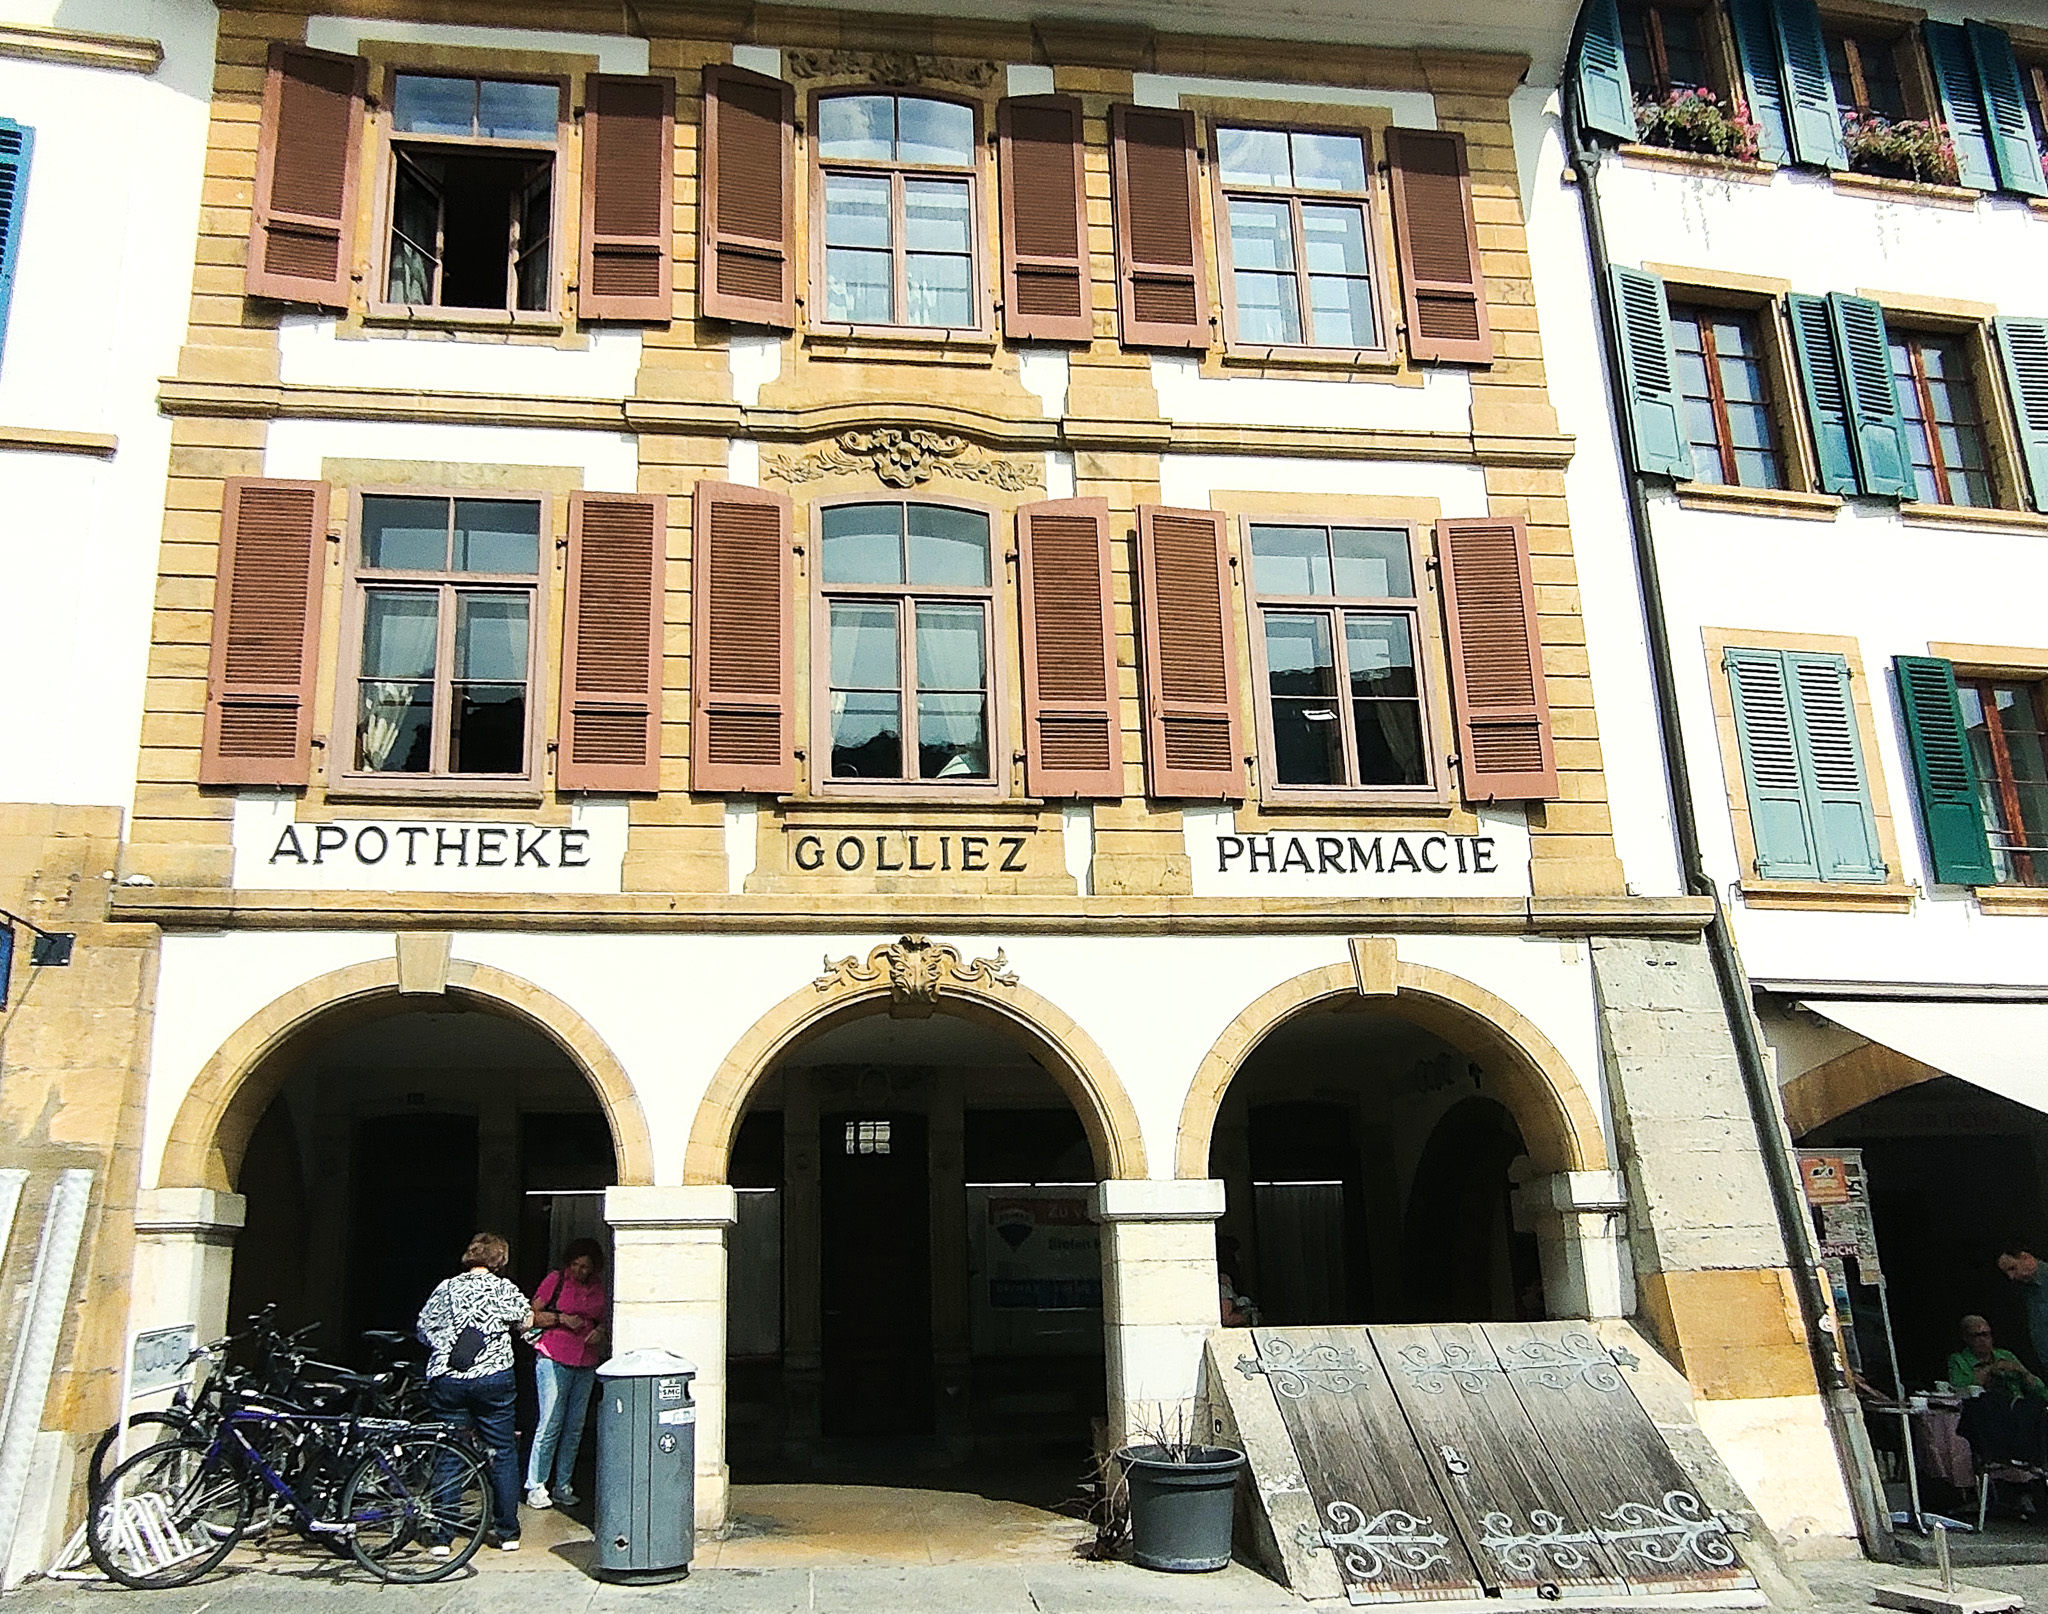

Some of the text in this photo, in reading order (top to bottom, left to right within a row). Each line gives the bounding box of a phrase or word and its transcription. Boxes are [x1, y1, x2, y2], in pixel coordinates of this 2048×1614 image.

[269, 825, 590, 867] APOTHEKE
[795, 836, 1027, 872] GOLLIEZ
[1216, 836, 1498, 874] PHARMACIE
